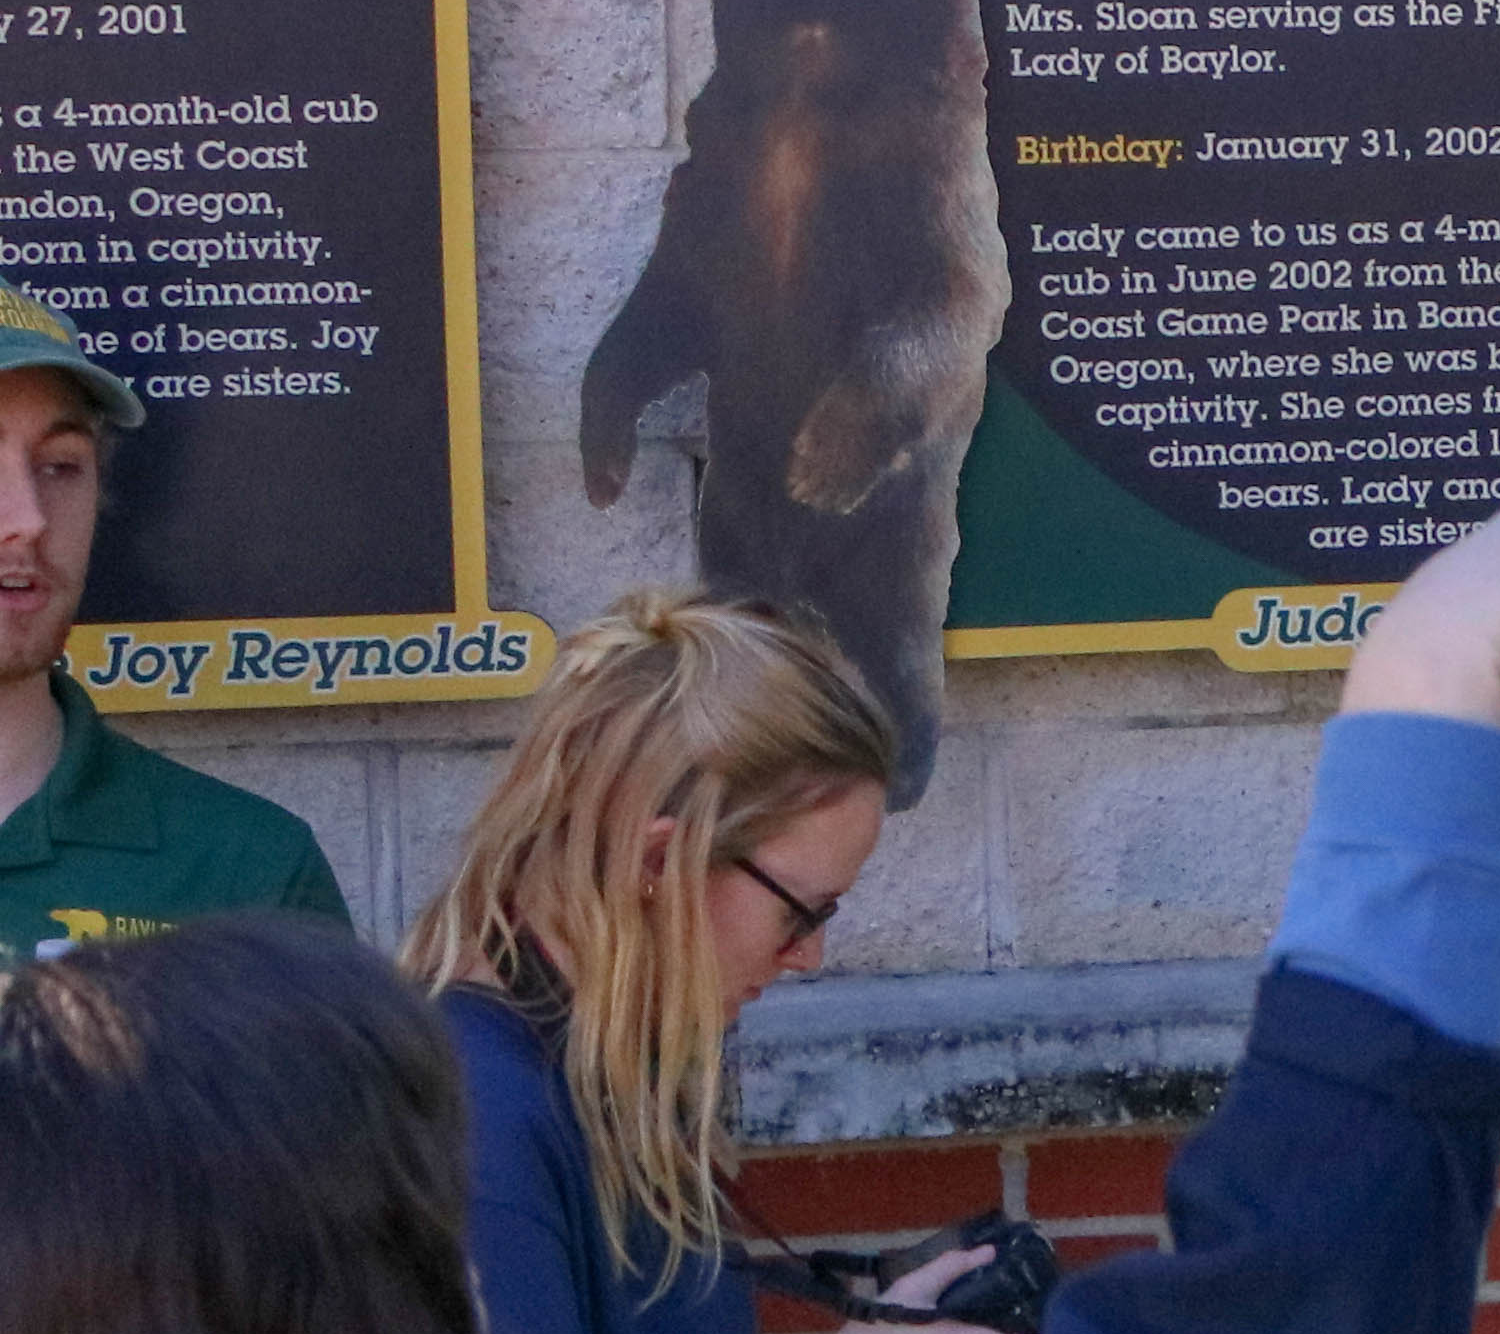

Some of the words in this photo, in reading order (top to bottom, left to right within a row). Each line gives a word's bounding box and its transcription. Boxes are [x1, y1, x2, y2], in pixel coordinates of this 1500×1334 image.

[27, 5, 83, 41] 27,
[98, 3, 187, 36] 2001
[1005, 3, 1083, 33] Mrs.
[1096, 1, 1198, 32] Sloan
[1208, 0, 1343, 36] serving
[1353, 3, 1395, 28] as
[1010, 46, 1105, 84] Lady
[1115, 44, 1149, 75] of
[1159, 43, 1286, 81] Baylor.
[14, 104, 43, 129] a
[53, 93, 292, 128] 4-month-old
[302, 93, 378, 125] cub
[12, 143, 77, 175] the
[86, 140, 185, 172] West
[196, 139, 309, 171] Coast
[1016, 133, 1183, 169] Birthday:
[1195, 132, 1350, 166] January
[1360, 127, 1412, 162] 31,
[0, 189, 115, 223] ndon,
[129, 186, 284, 225] Oregon,
[0, 235, 87, 266] born
[97, 232, 137, 263] in
[147, 229, 332, 269] captivity.
[121, 284, 150, 309] a
[160, 277, 372, 308] cinnamon-
[1039, 266, 1111, 297] cub
[1120, 265, 1158, 295] in
[1166, 263, 1257, 295] June
[1268, 259, 1352, 291] 2002
[1363, 257, 1448, 288] from
[130, 322, 167, 354] of
[177, 322, 298, 353] bears.
[311, 319, 380, 357] Joy
[1040, 309, 1146, 341] Coast
[1156, 307, 1269, 337] Game
[1278, 302, 1362, 334] Park
[1372, 302, 1408, 332] in
[146, 374, 212, 400] are
[222, 366, 351, 397] sisters.
[1095, 393, 1268, 431] captivity.
[1280, 390, 1346, 421] She
[1355, 391, 1472, 419] comes
[1148, 429, 1481, 469] cinnamon-colored
[1218, 480, 1329, 510] bears.
[1341, 473, 1433, 510] Lady
[1308, 525, 1369, 549] are
[1379, 516, 1484, 547] sister
[89, 634, 210, 695] Joy
[225, 624, 529, 694] Reynolds
